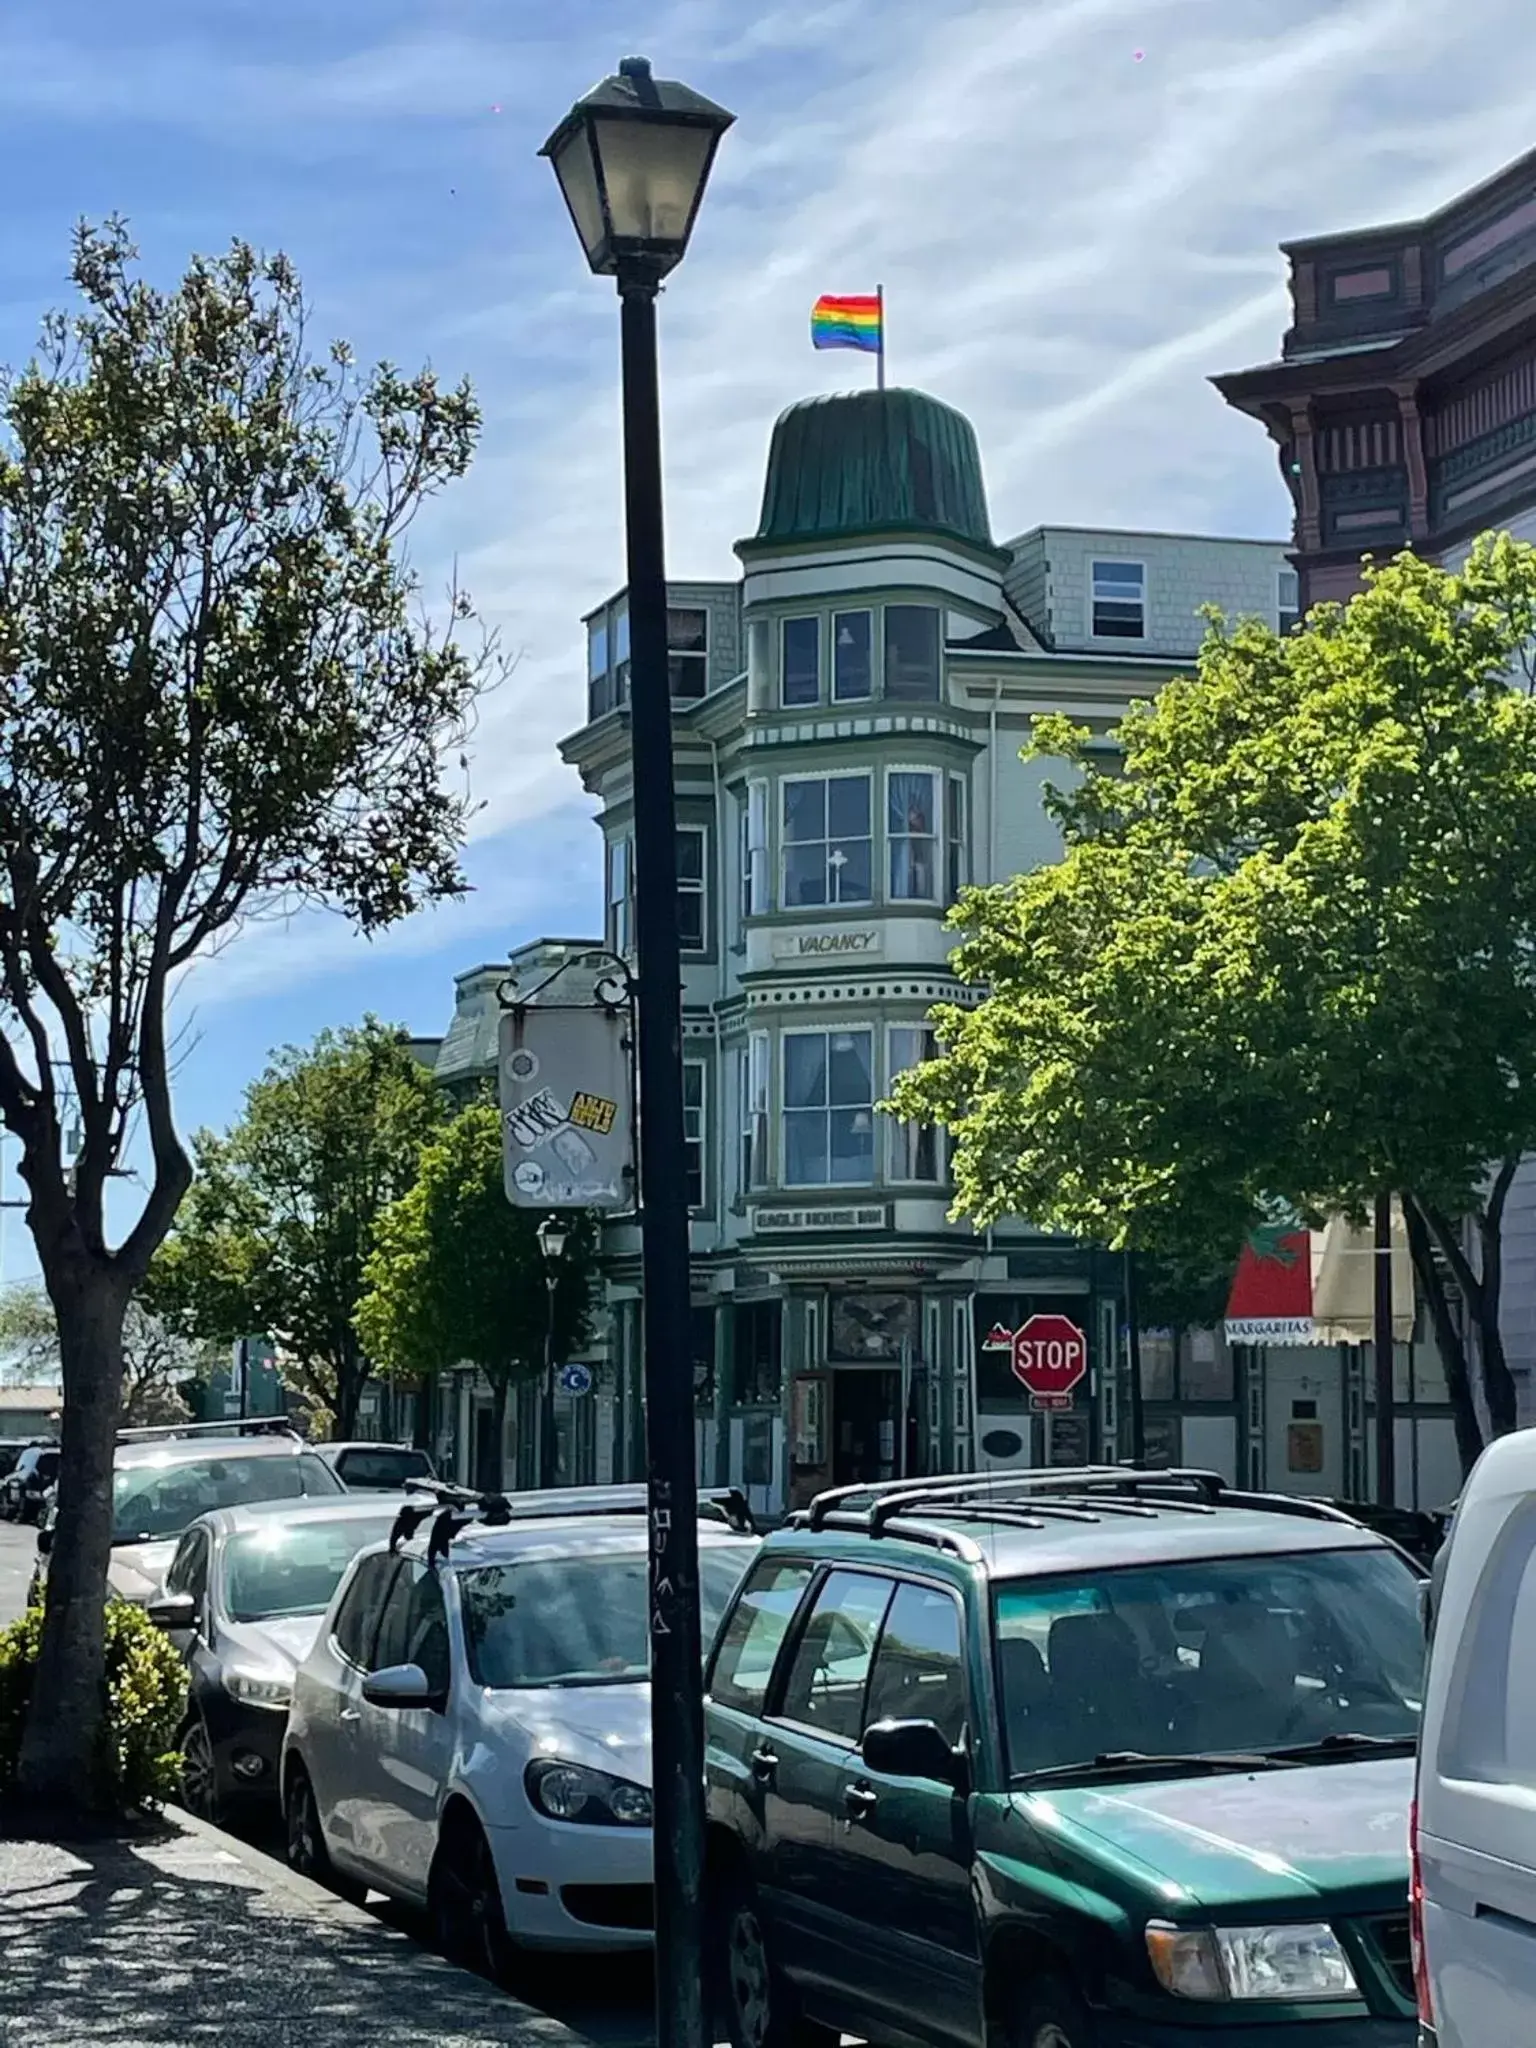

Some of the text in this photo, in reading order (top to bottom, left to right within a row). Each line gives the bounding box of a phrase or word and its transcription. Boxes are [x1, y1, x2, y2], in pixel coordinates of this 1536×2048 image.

[799, 932, 876, 953] VACANCY
[1225, 1321, 1310, 1335] MARGARITAS
[1018, 1341, 1080, 1370] STOP
